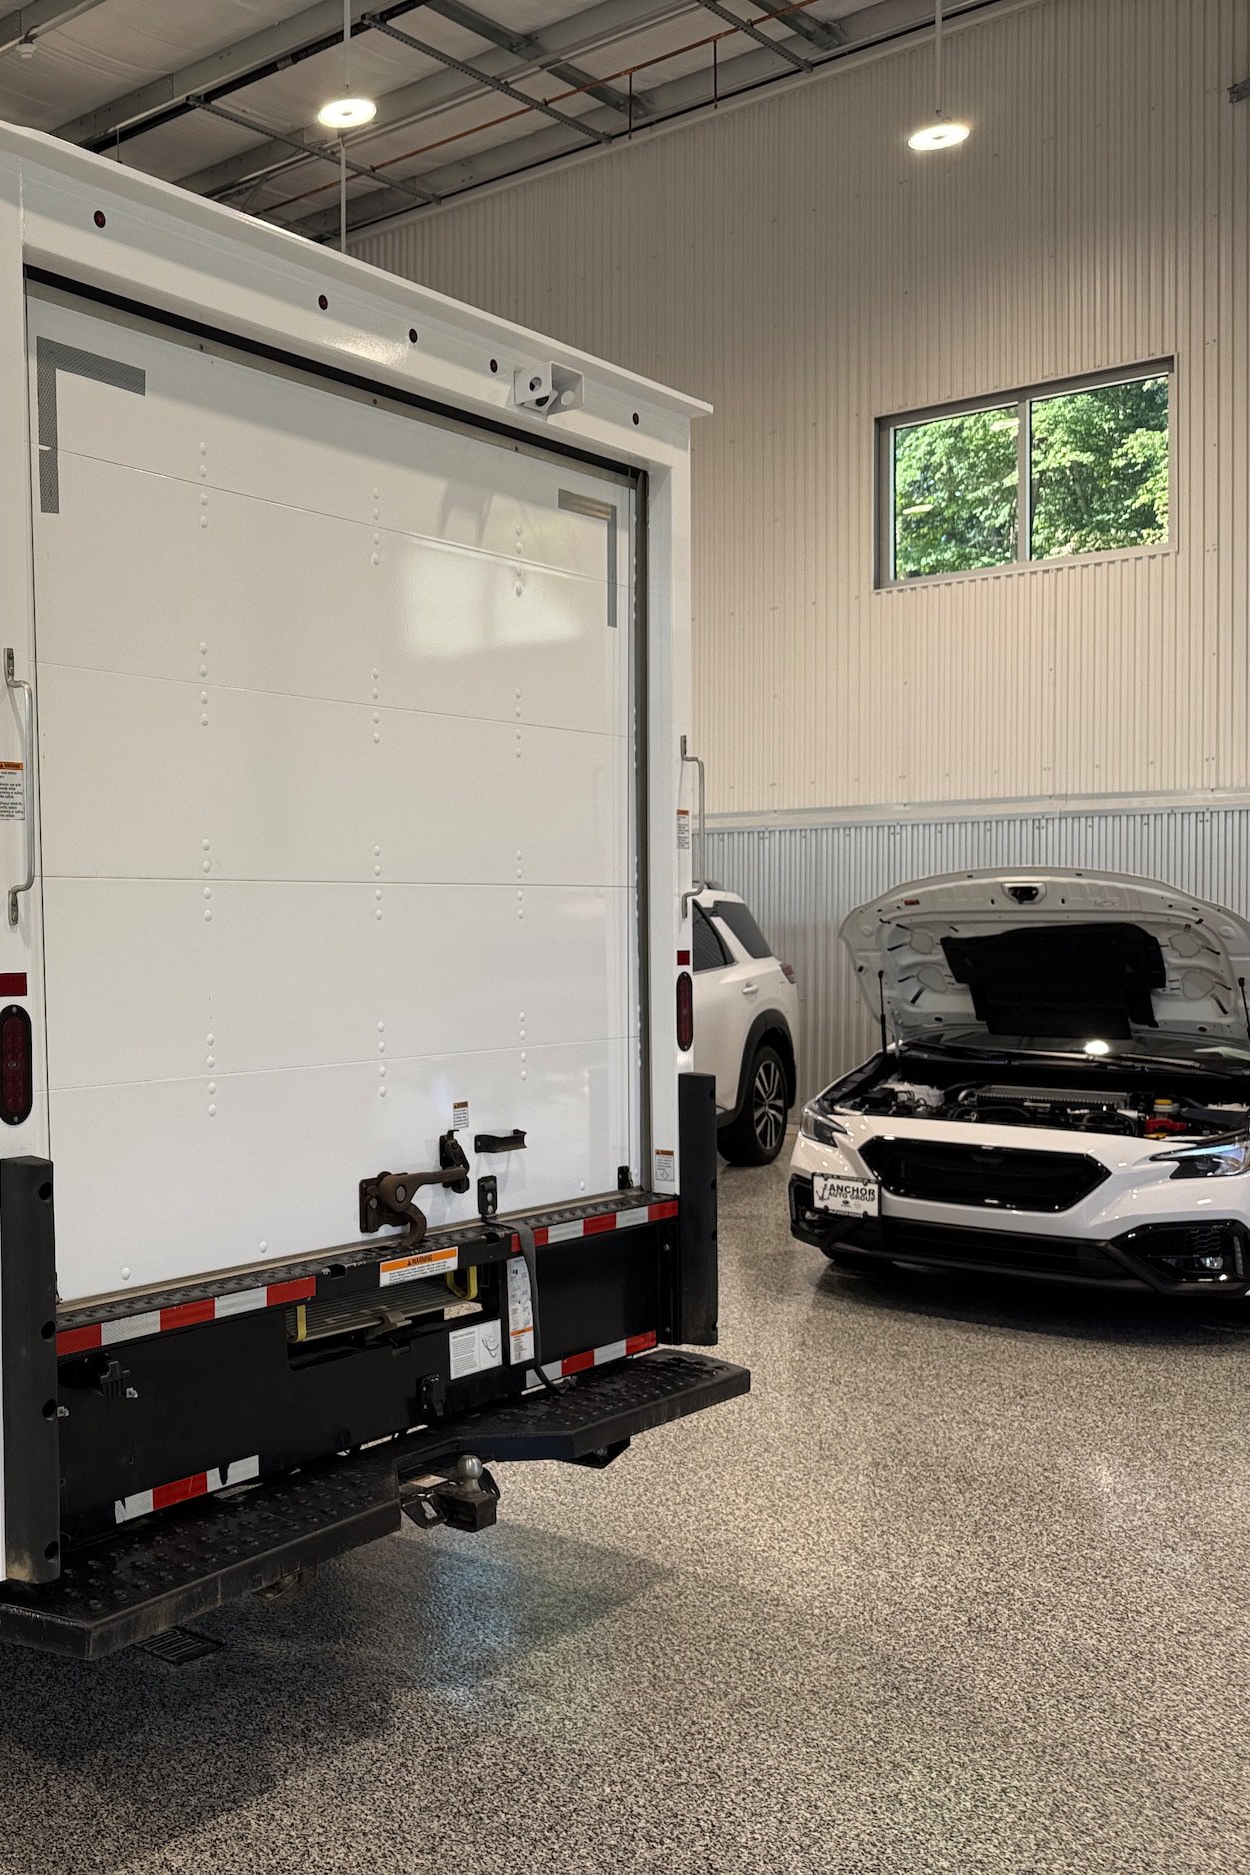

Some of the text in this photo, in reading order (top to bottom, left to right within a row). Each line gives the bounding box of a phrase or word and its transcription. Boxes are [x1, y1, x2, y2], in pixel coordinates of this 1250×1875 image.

[829, 1183, 876, 1197] ANCHOR
[828, 1191, 876, 1203] AUTO GROUP
